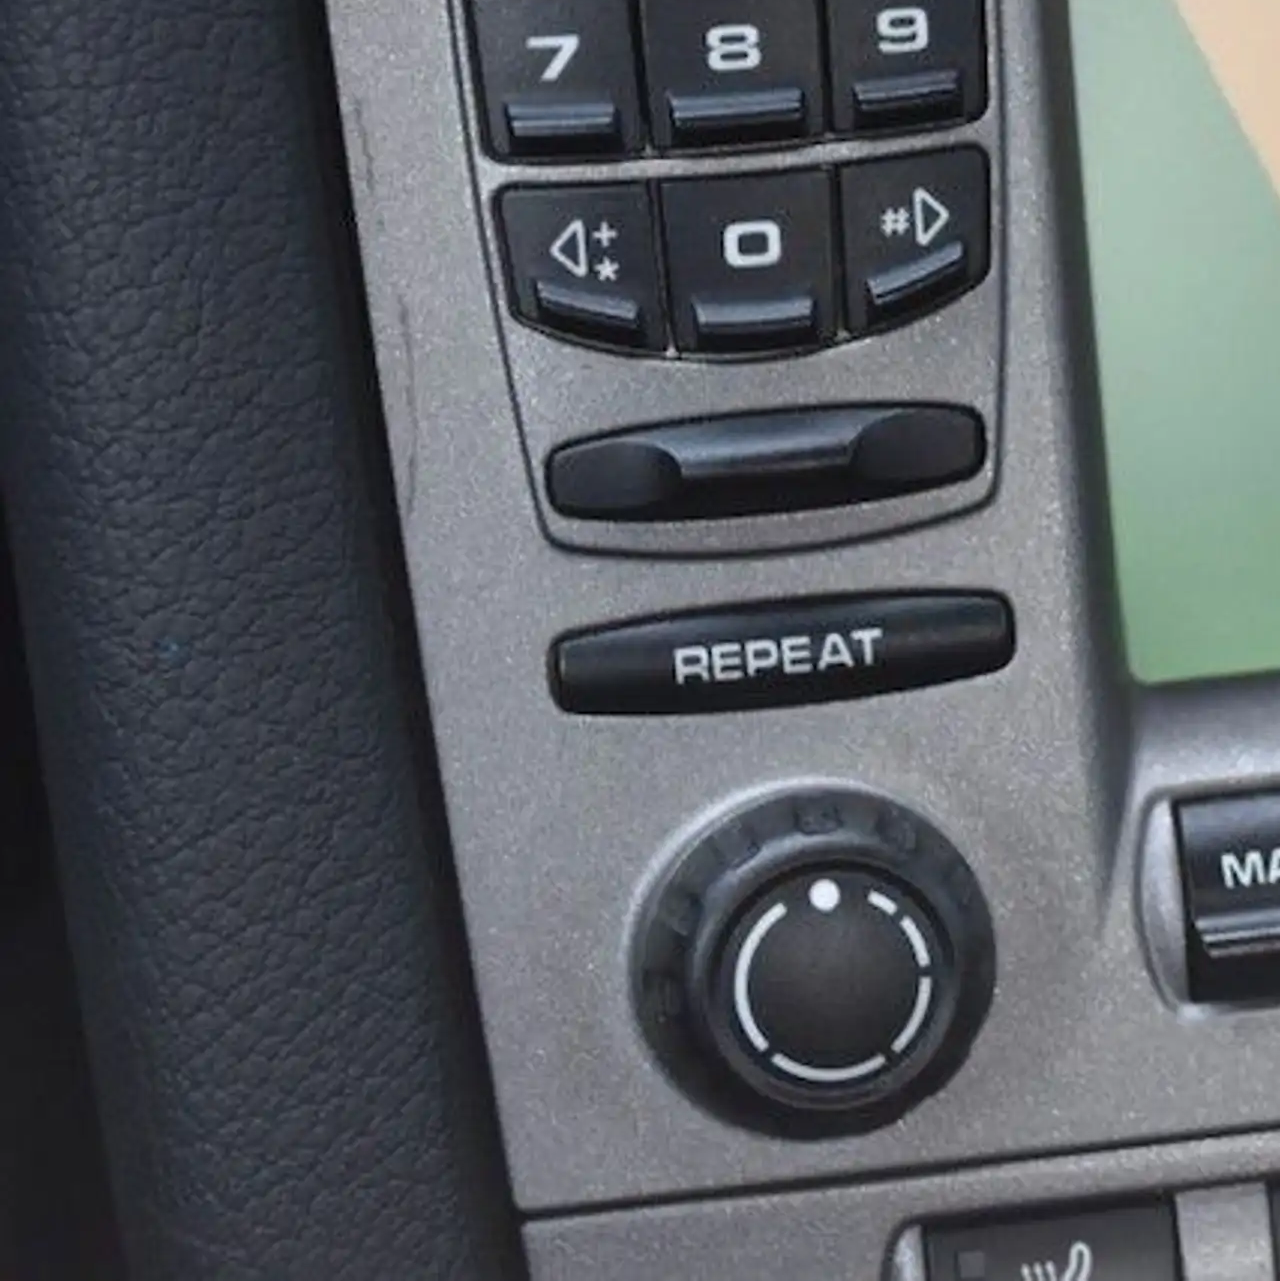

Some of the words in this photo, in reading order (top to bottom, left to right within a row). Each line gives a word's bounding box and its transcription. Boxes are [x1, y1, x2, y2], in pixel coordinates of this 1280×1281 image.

[706, 24, 762, 71] 8
[876, 7, 929, 54] 9
[526, 34, 580, 81] 7
[672, 627, 884, 686] REPEAT
